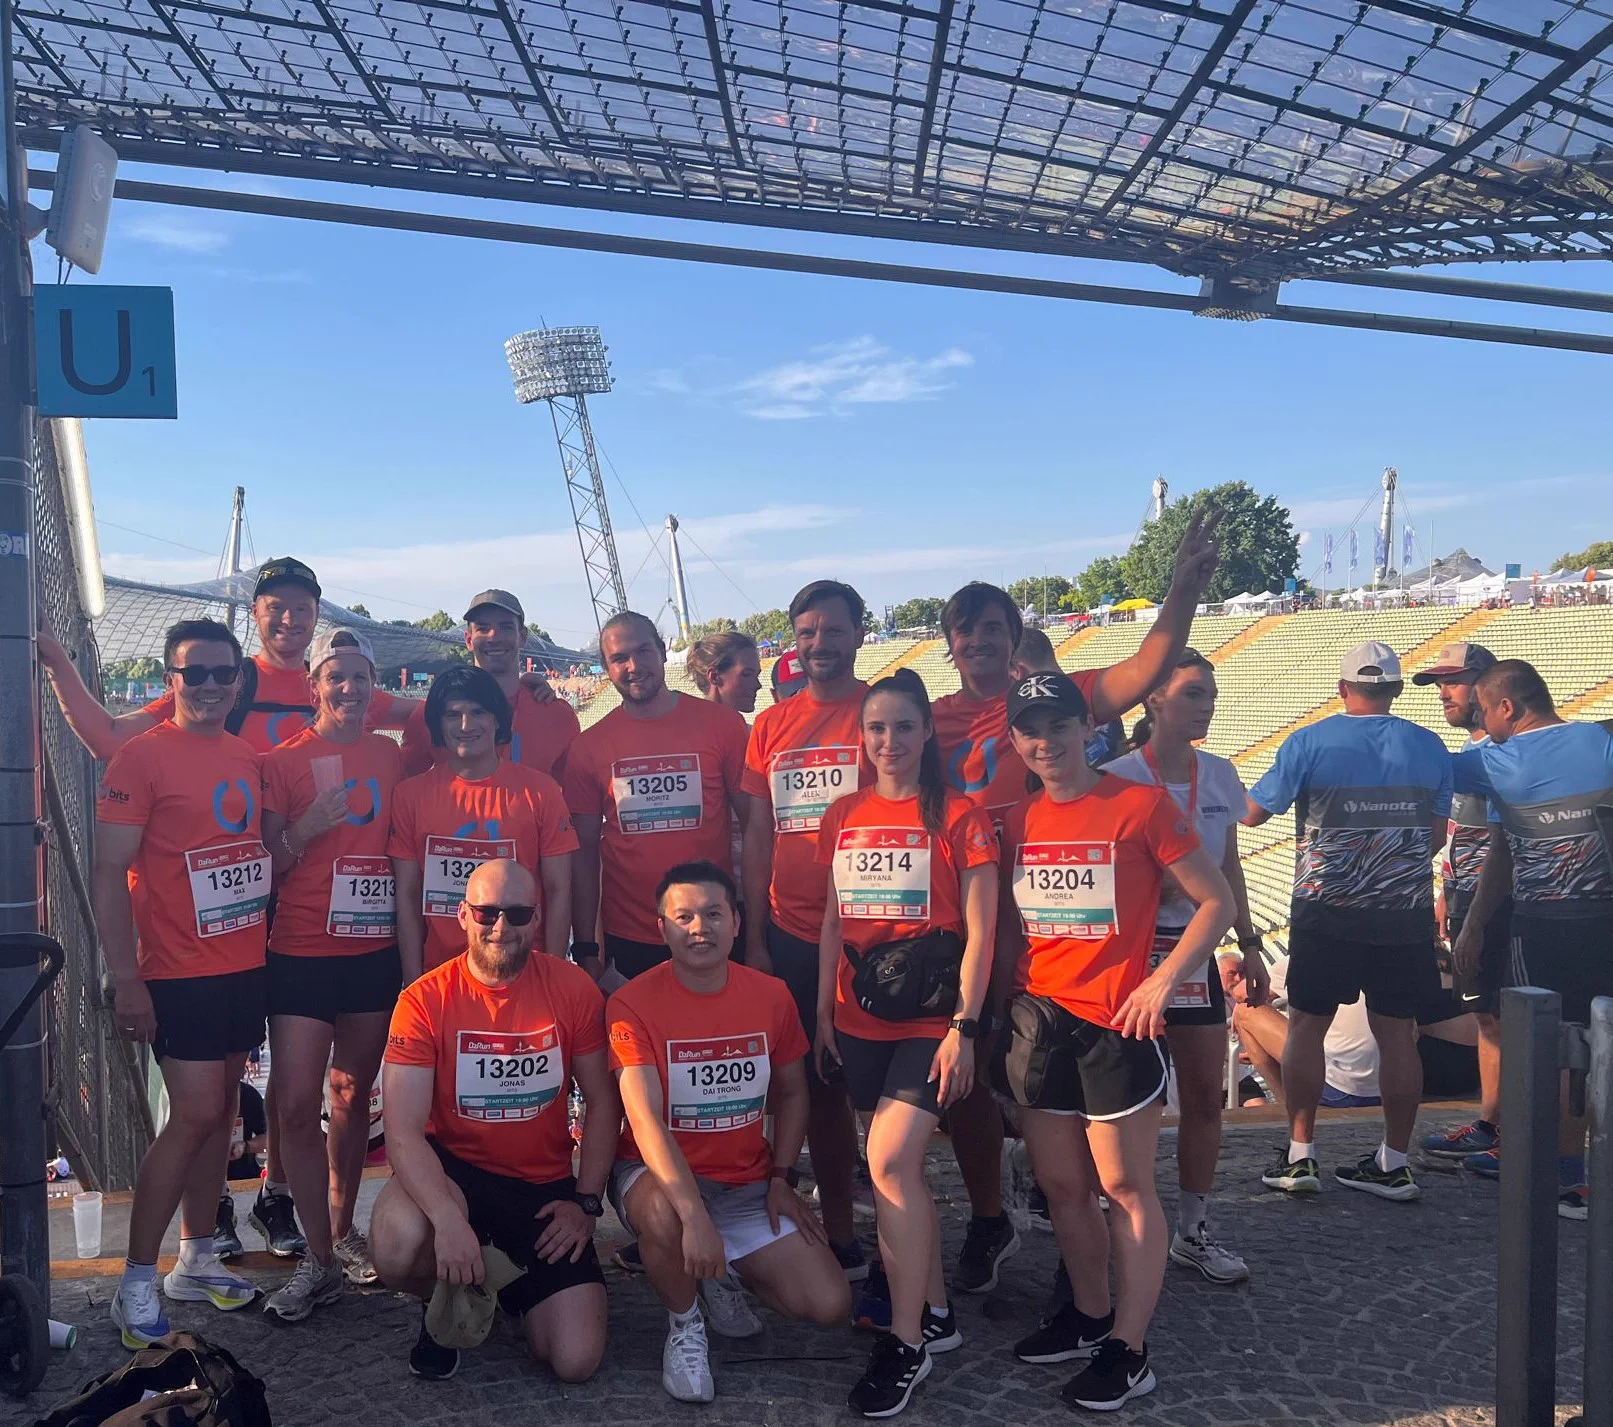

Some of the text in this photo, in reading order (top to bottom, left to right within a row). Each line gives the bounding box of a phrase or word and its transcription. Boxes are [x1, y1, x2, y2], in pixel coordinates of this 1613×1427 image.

[627, 774, 688, 796] 13205
[782, 768, 843, 791] 13210
[109, 785, 130, 802] bits
[645, 794, 670, 802] MORITZ
[440, 858, 484, 879] 132
[845, 851, 912, 872] 13214
[207, 862, 263, 891] 13212
[1026, 868, 1096, 890] 13204
[233, 887, 246, 896] MAX
[349, 878, 396, 897] 13213
[1044, 892, 1074, 900] ANDREA
[475, 1054, 549, 1079] 13202
[687, 1060, 756, 1087] 13209
[702, 1085, 742, 1095] DAI TRONG
